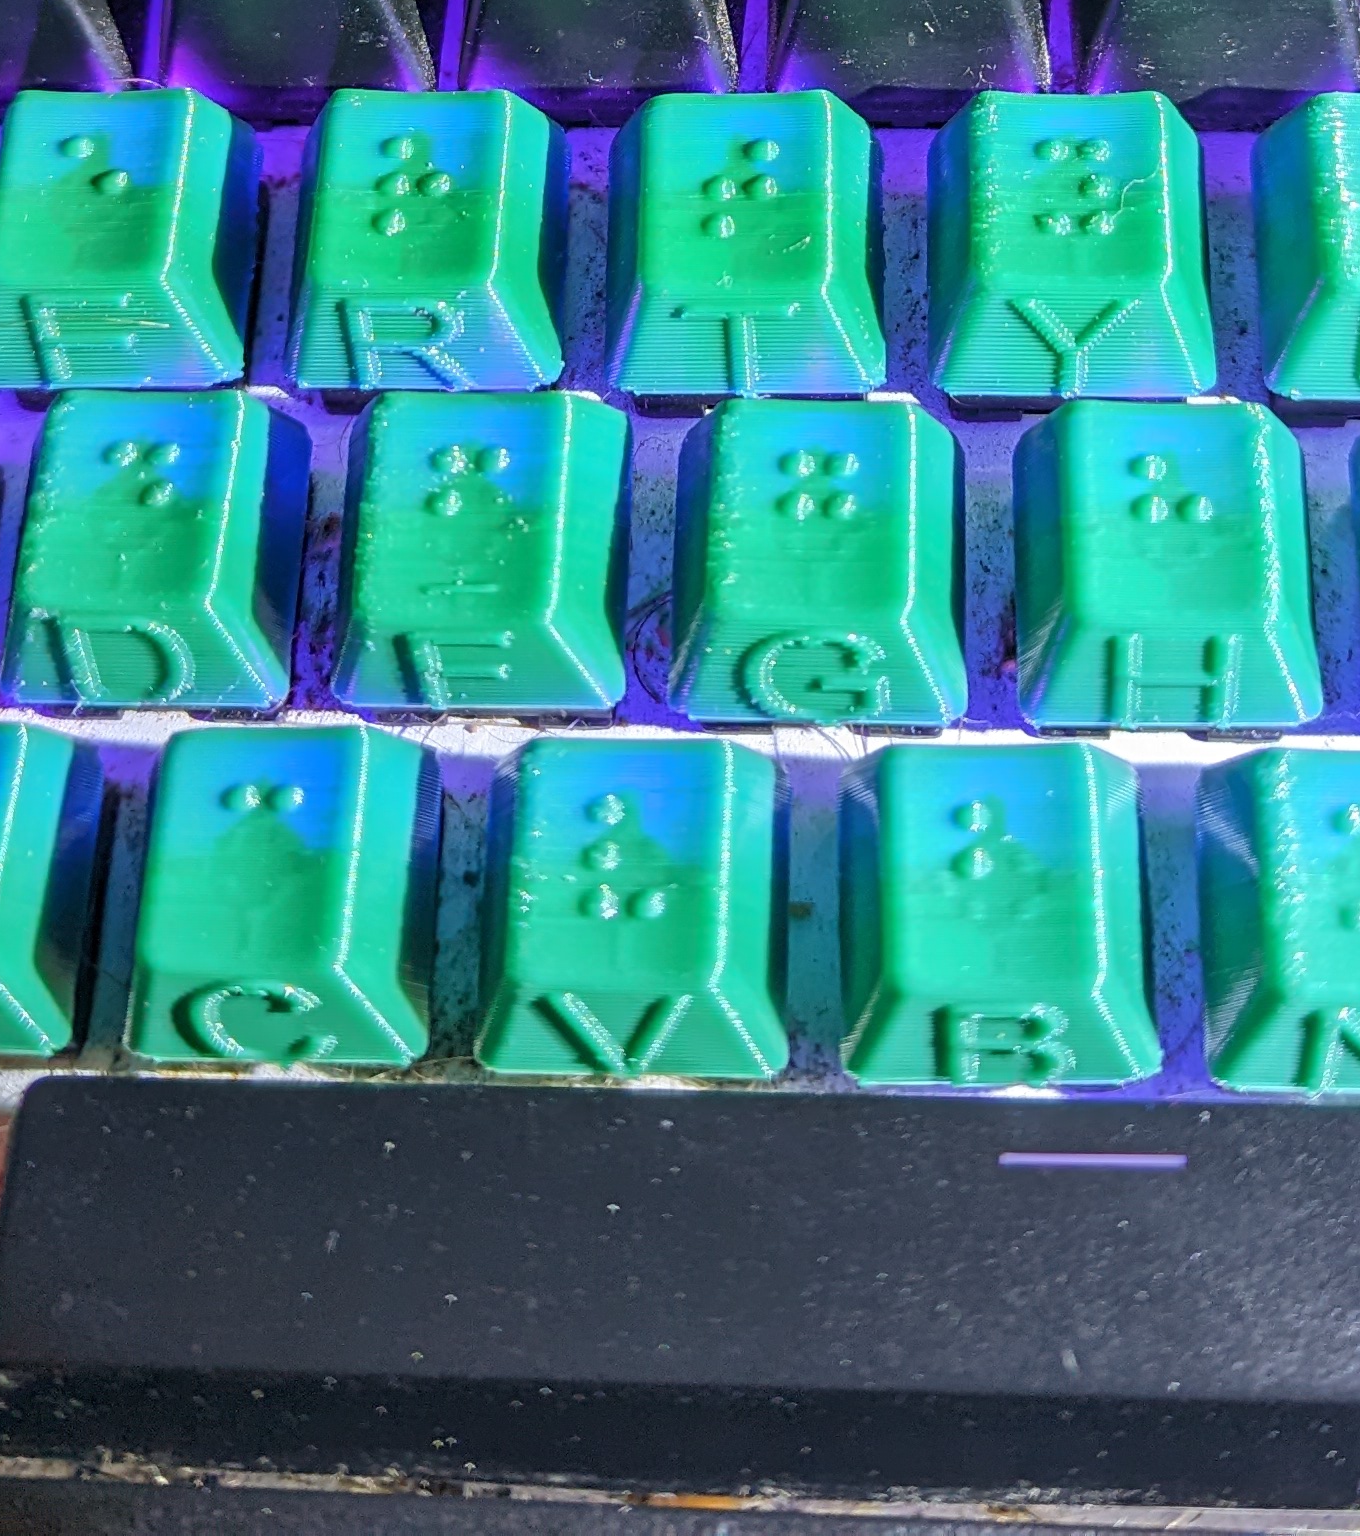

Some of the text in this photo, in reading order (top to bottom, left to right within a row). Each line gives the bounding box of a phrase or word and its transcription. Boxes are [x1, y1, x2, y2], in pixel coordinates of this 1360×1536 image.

[336, 296, 477, 389] R
[672, 299, 800, 396] T
[1008, 299, 1140, 396] Y
[44, 614, 196, 706] D
[738, 630, 890, 723] G
[1102, 633, 1242, 728] H
[172, 981, 338, 1062] C
[533, 991, 693, 1072] V
